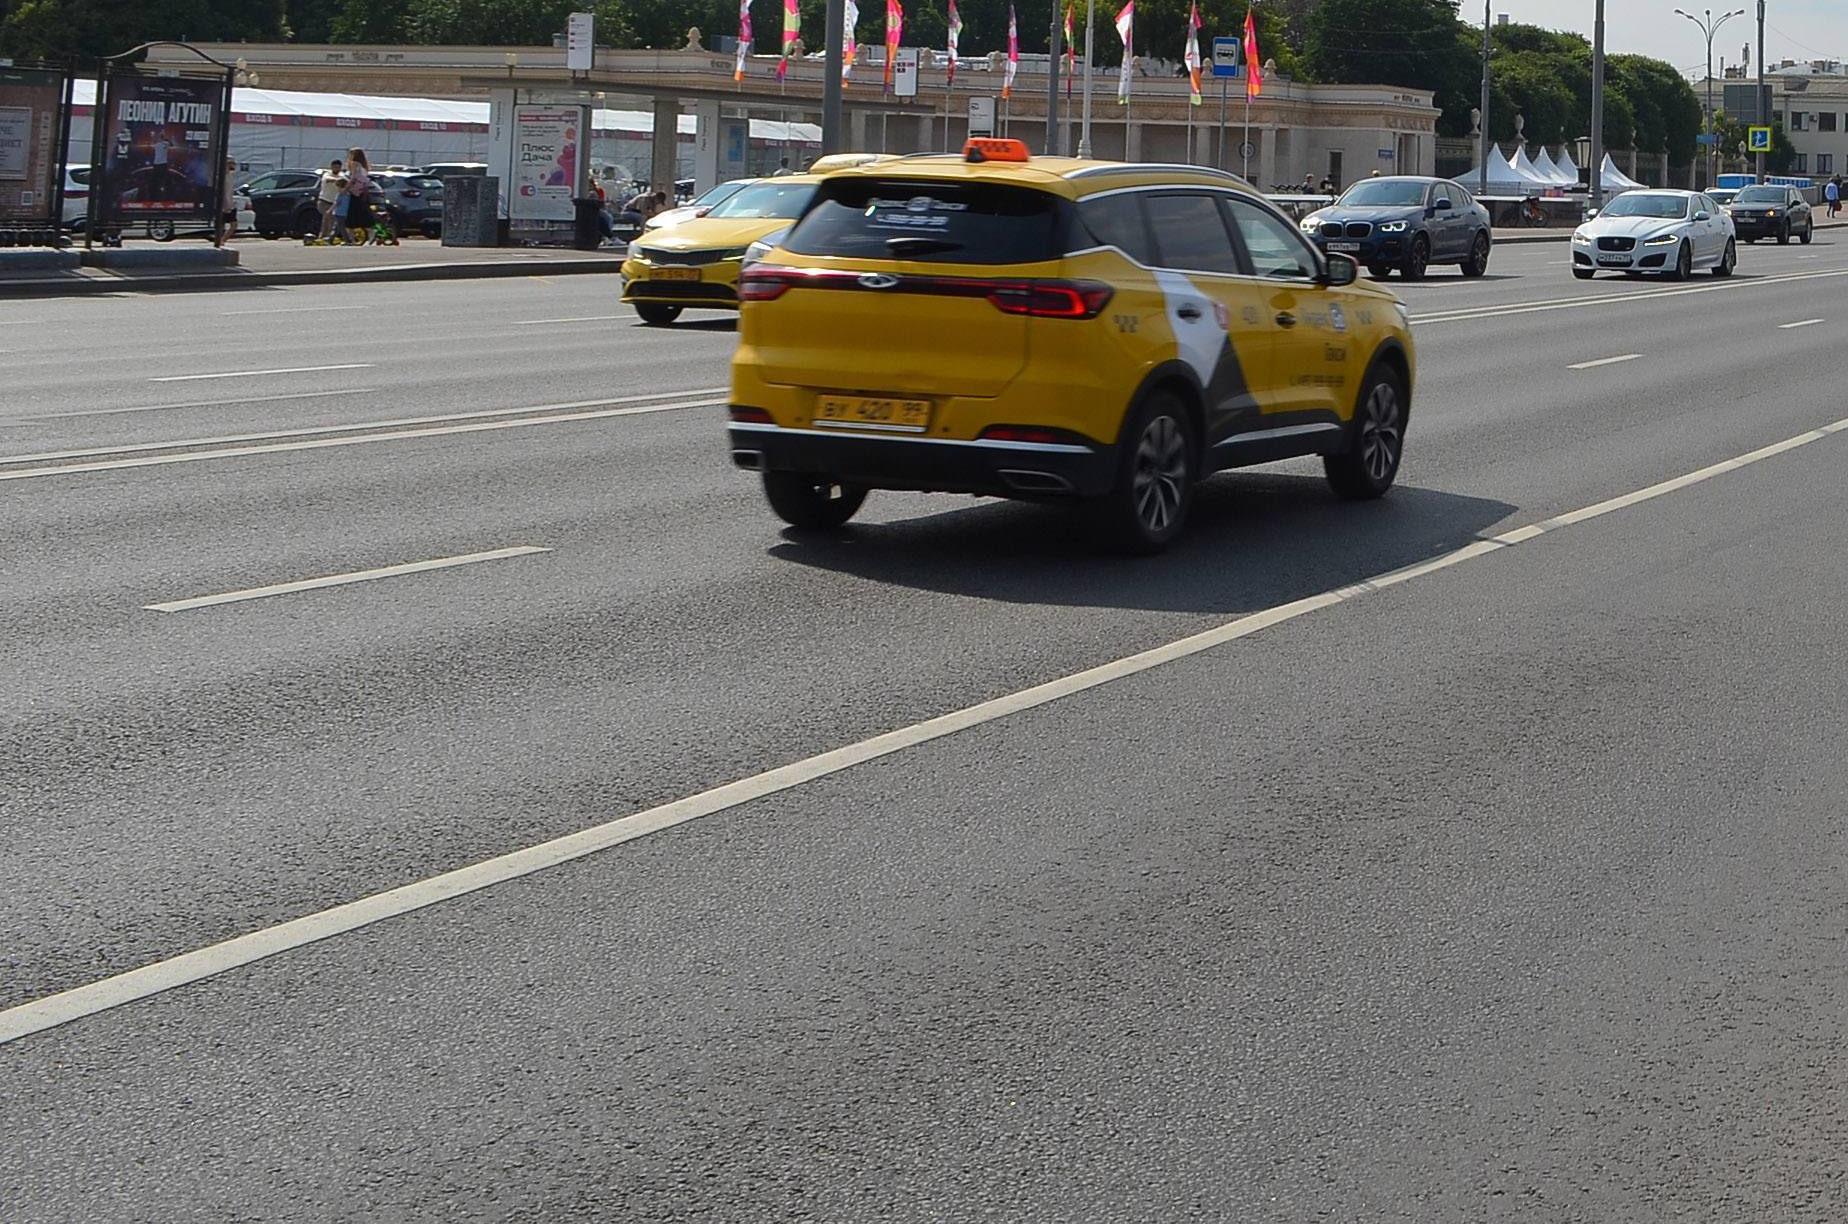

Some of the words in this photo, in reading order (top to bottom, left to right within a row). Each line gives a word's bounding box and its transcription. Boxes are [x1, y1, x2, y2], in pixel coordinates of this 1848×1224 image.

[117, 100, 165, 125] ЛЕОНИД
[168, 102, 212, 124] АГУТИН
[521, 143, 556, 152] Плюс
[521, 152, 553, 162] Дача
